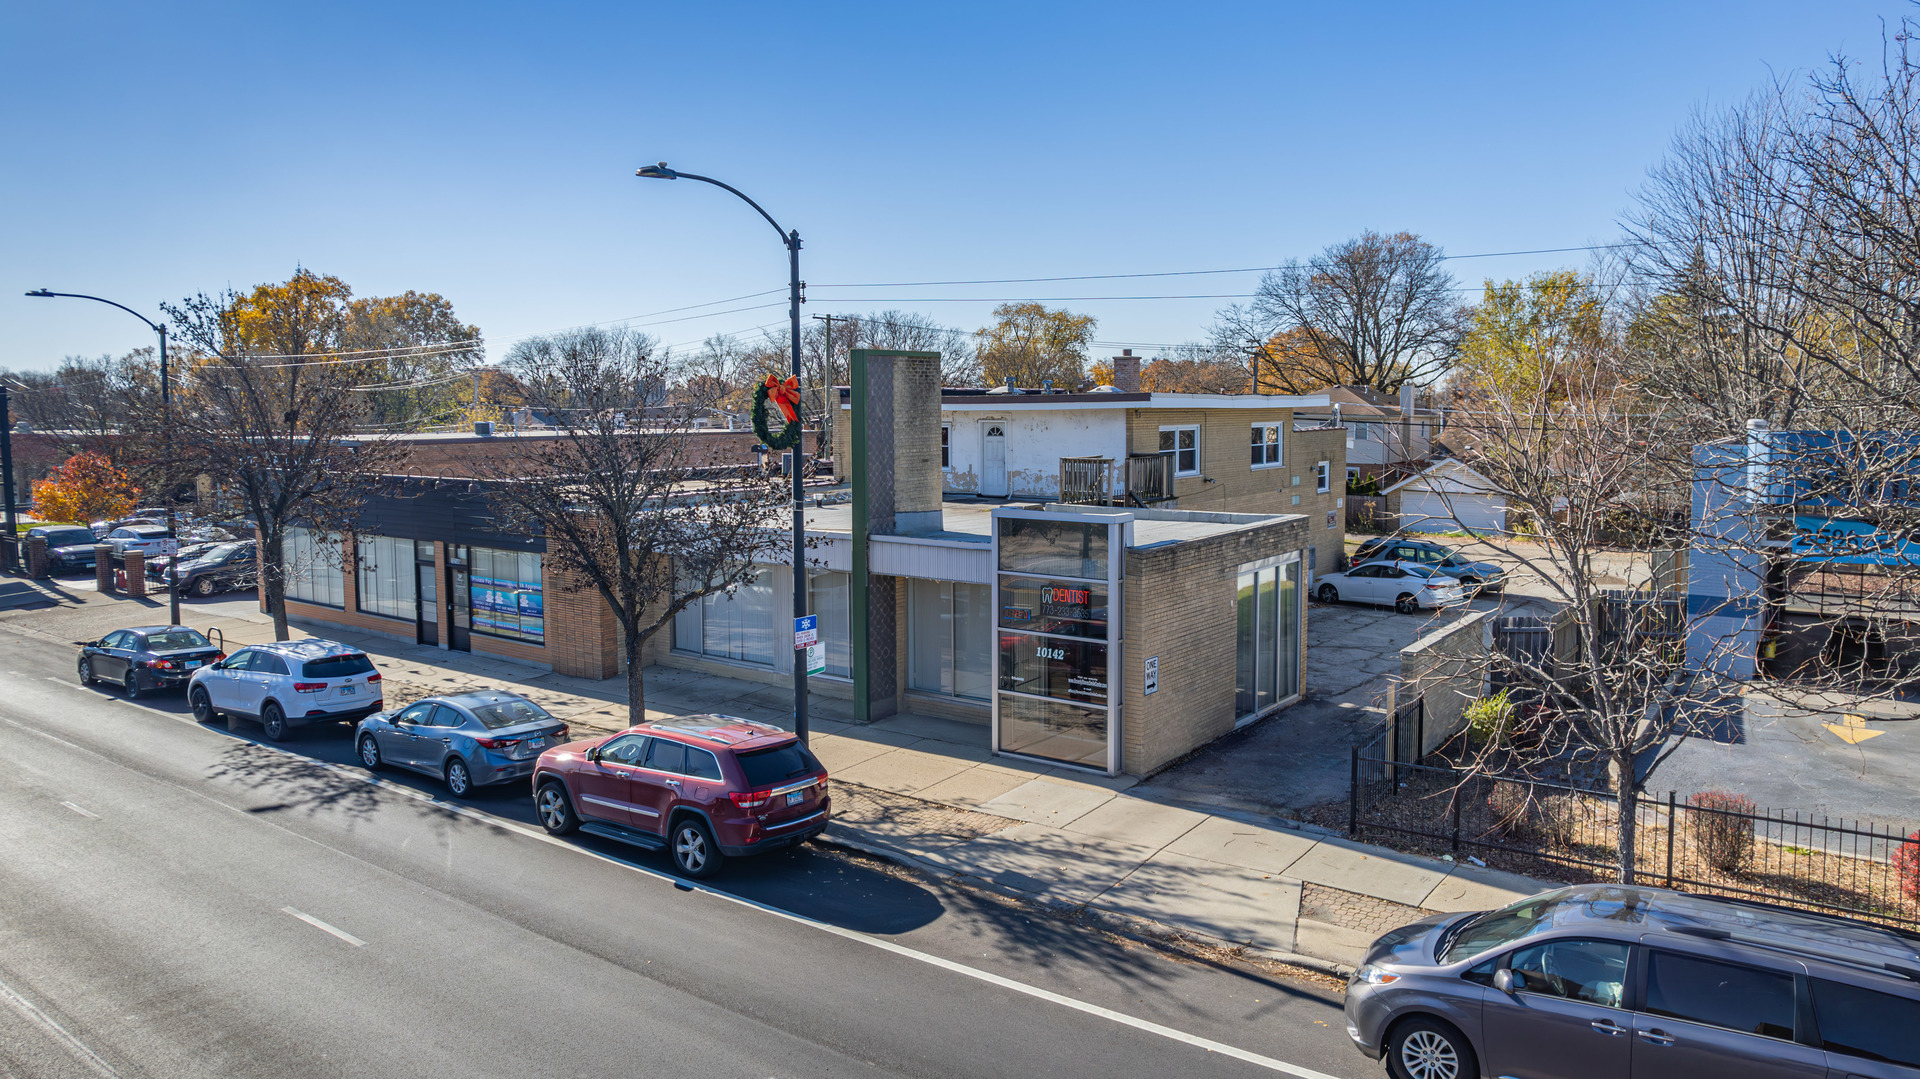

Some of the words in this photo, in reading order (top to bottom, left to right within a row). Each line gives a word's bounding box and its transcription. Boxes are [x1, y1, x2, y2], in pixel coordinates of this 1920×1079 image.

[1053, 588, 1090, 604] DENTIST
[1036, 647, 1065, 660] 10142
[1147, 660, 1156, 670] ONE
[1147, 670, 1156, 680] WAY
